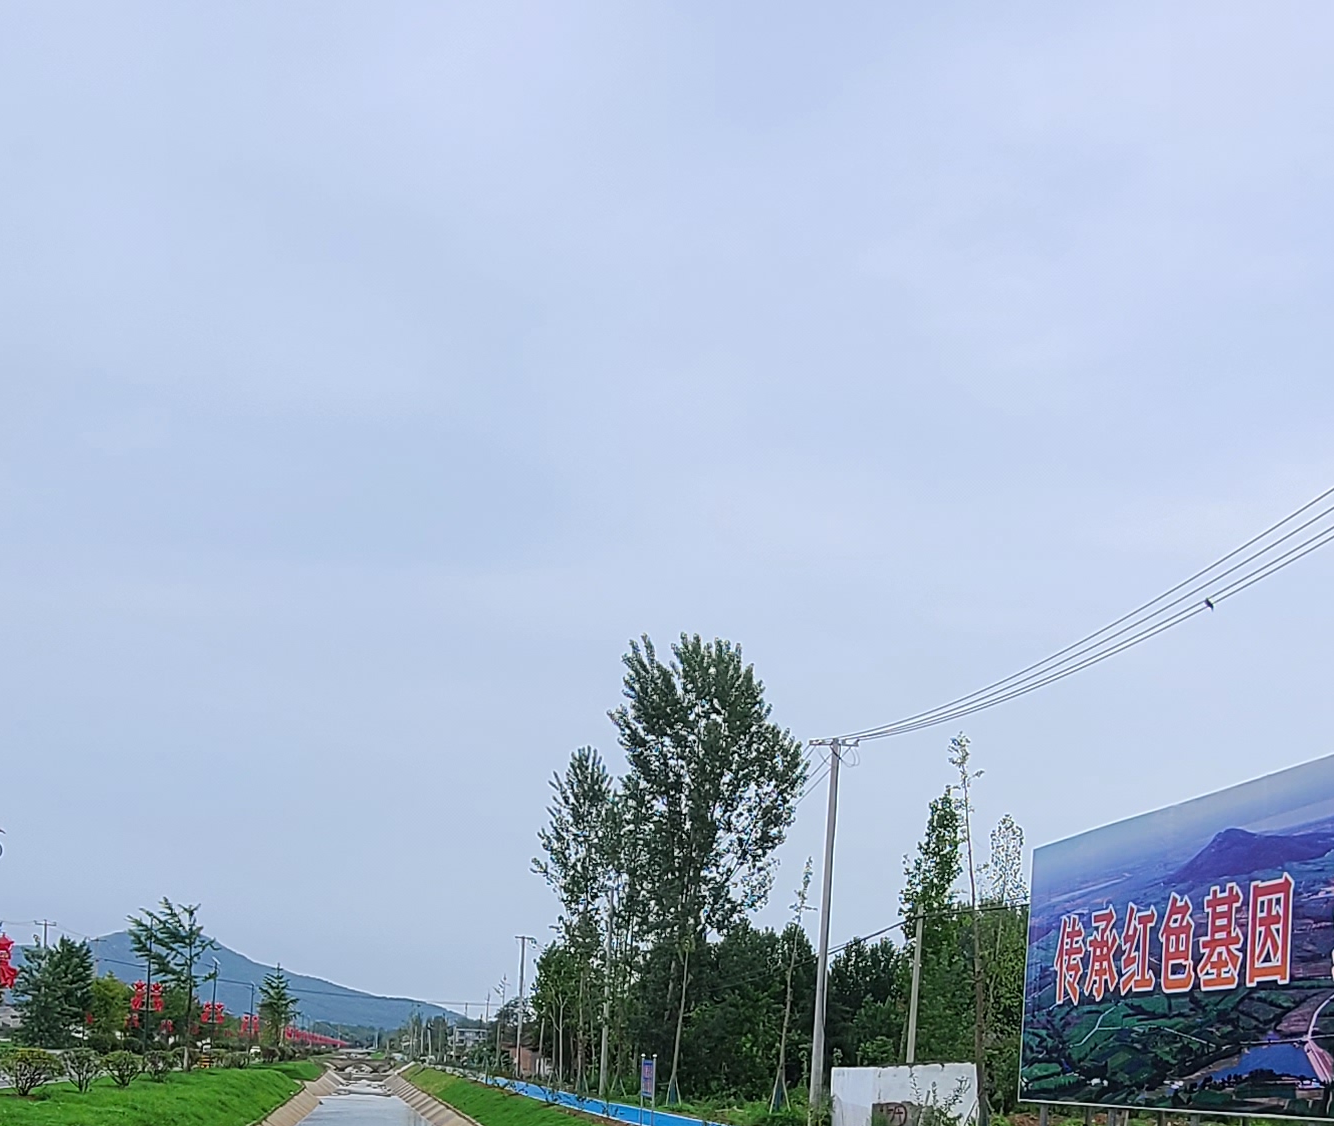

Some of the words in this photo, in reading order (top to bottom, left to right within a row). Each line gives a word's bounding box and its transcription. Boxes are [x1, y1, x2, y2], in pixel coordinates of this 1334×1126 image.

[1054, 872, 1295, 1005] 传承红色基因
